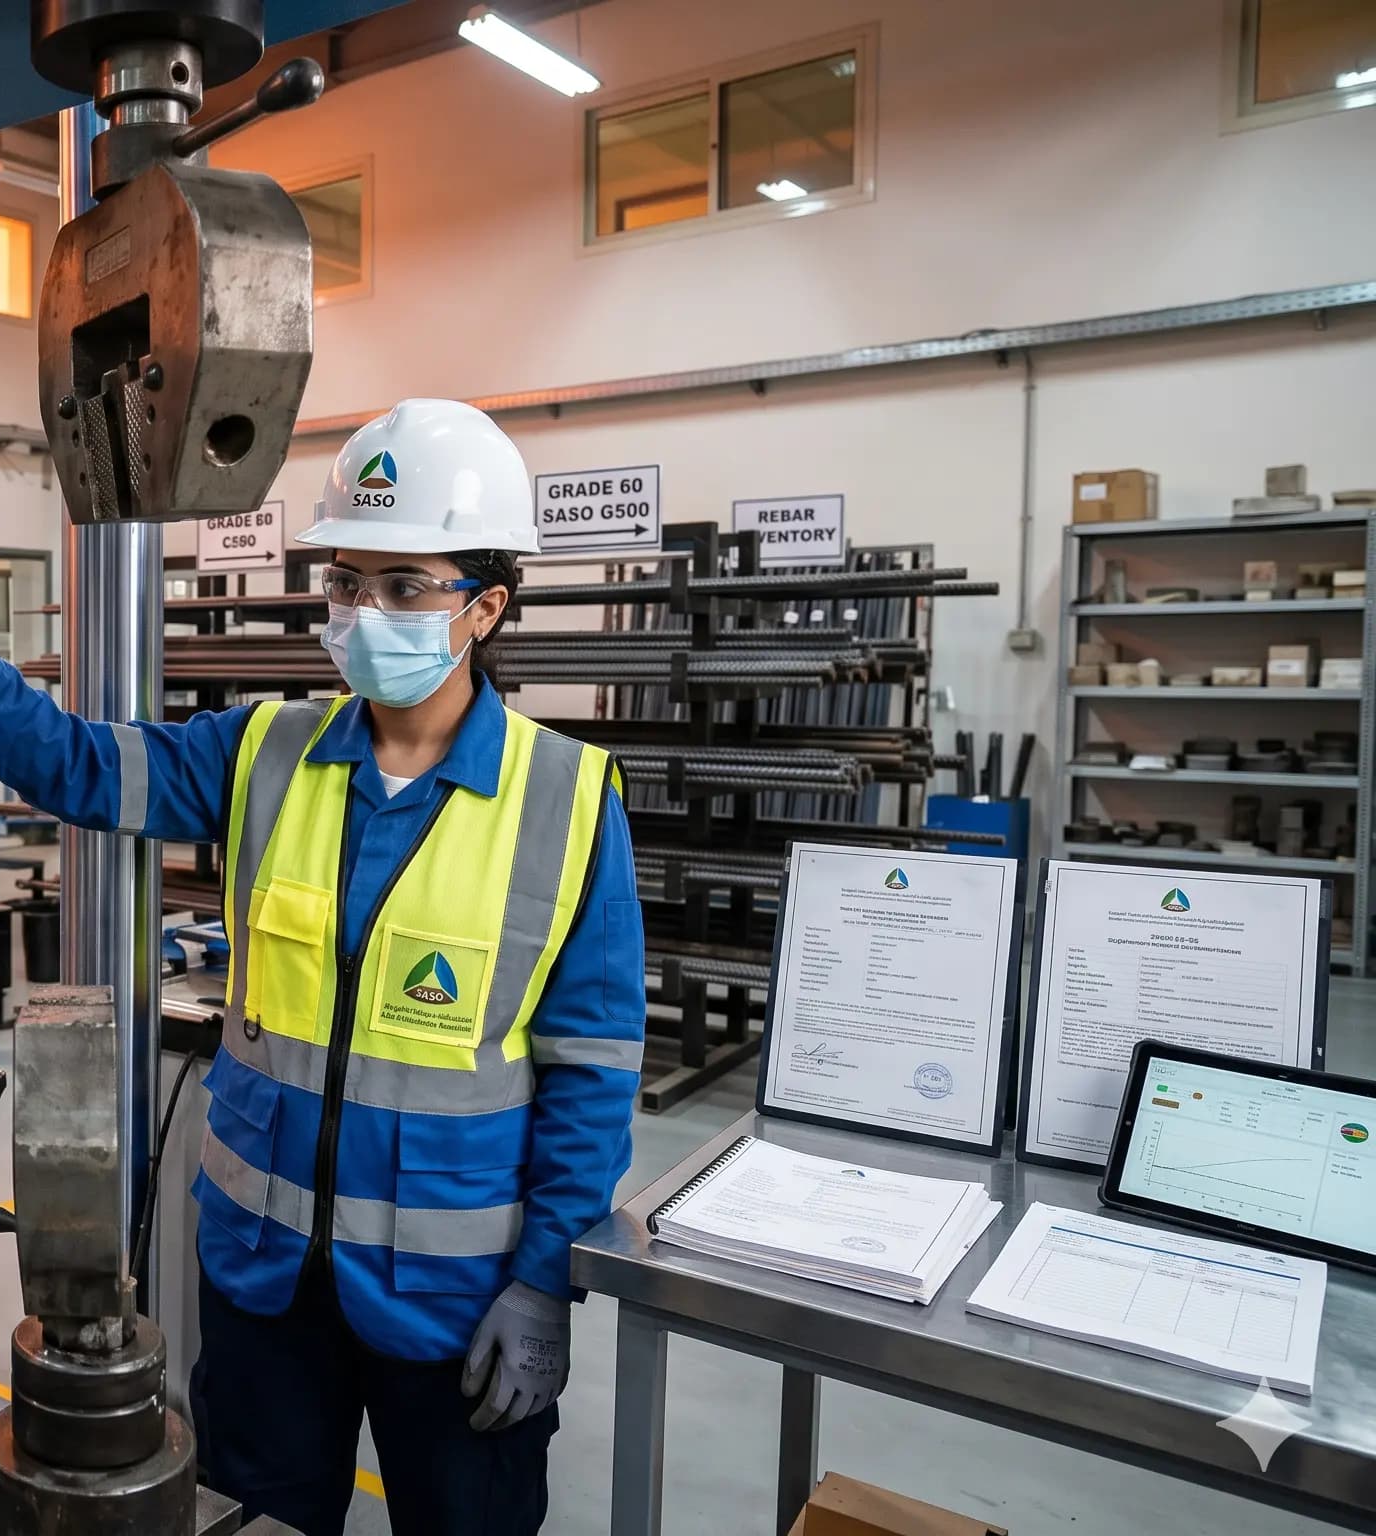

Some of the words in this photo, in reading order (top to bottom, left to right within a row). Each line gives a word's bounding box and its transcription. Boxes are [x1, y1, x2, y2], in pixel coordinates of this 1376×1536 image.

[548, 480, 613, 499] GRADE
[620, 478, 642, 494] 60
[352, 493, 395, 508] SASO
[542, 506, 593, 523] SASO
[601, 502, 649, 520] G500
[758, 508, 815, 523] REBAR
[207, 514, 252, 530] GRADE
[759, 528, 836, 544] VENTORY
[415, 988, 444, 1002] SASO
